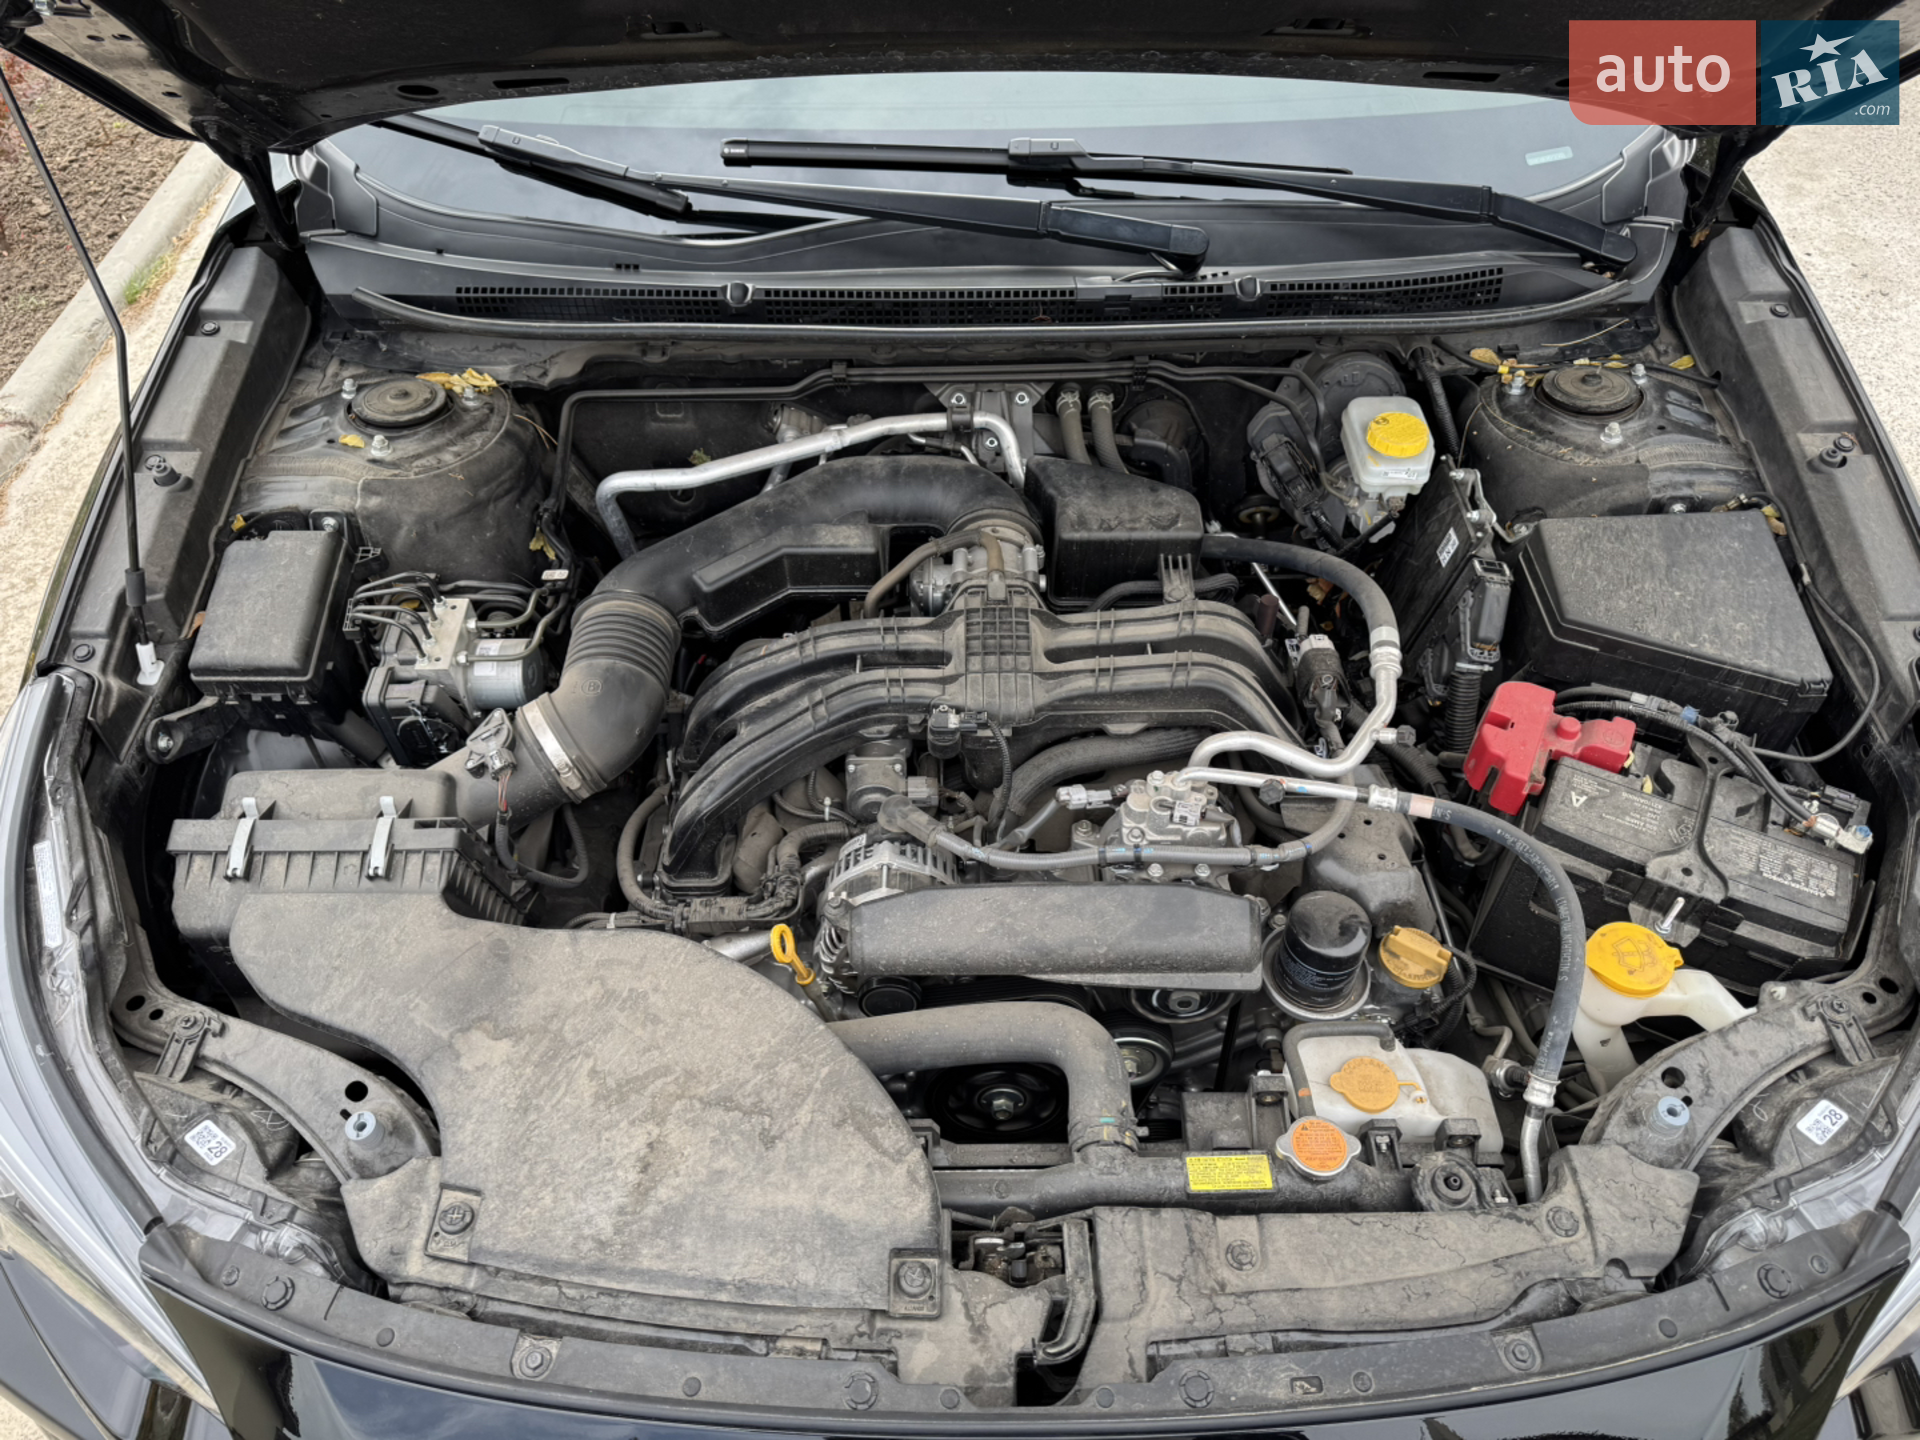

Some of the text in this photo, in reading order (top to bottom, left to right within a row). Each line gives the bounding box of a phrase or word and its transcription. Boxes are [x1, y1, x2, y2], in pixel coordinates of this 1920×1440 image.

[1571, 791, 1588, 808] A
[1823, 1108, 1843, 1127] 28
[207, 1141, 228, 1159] 28
